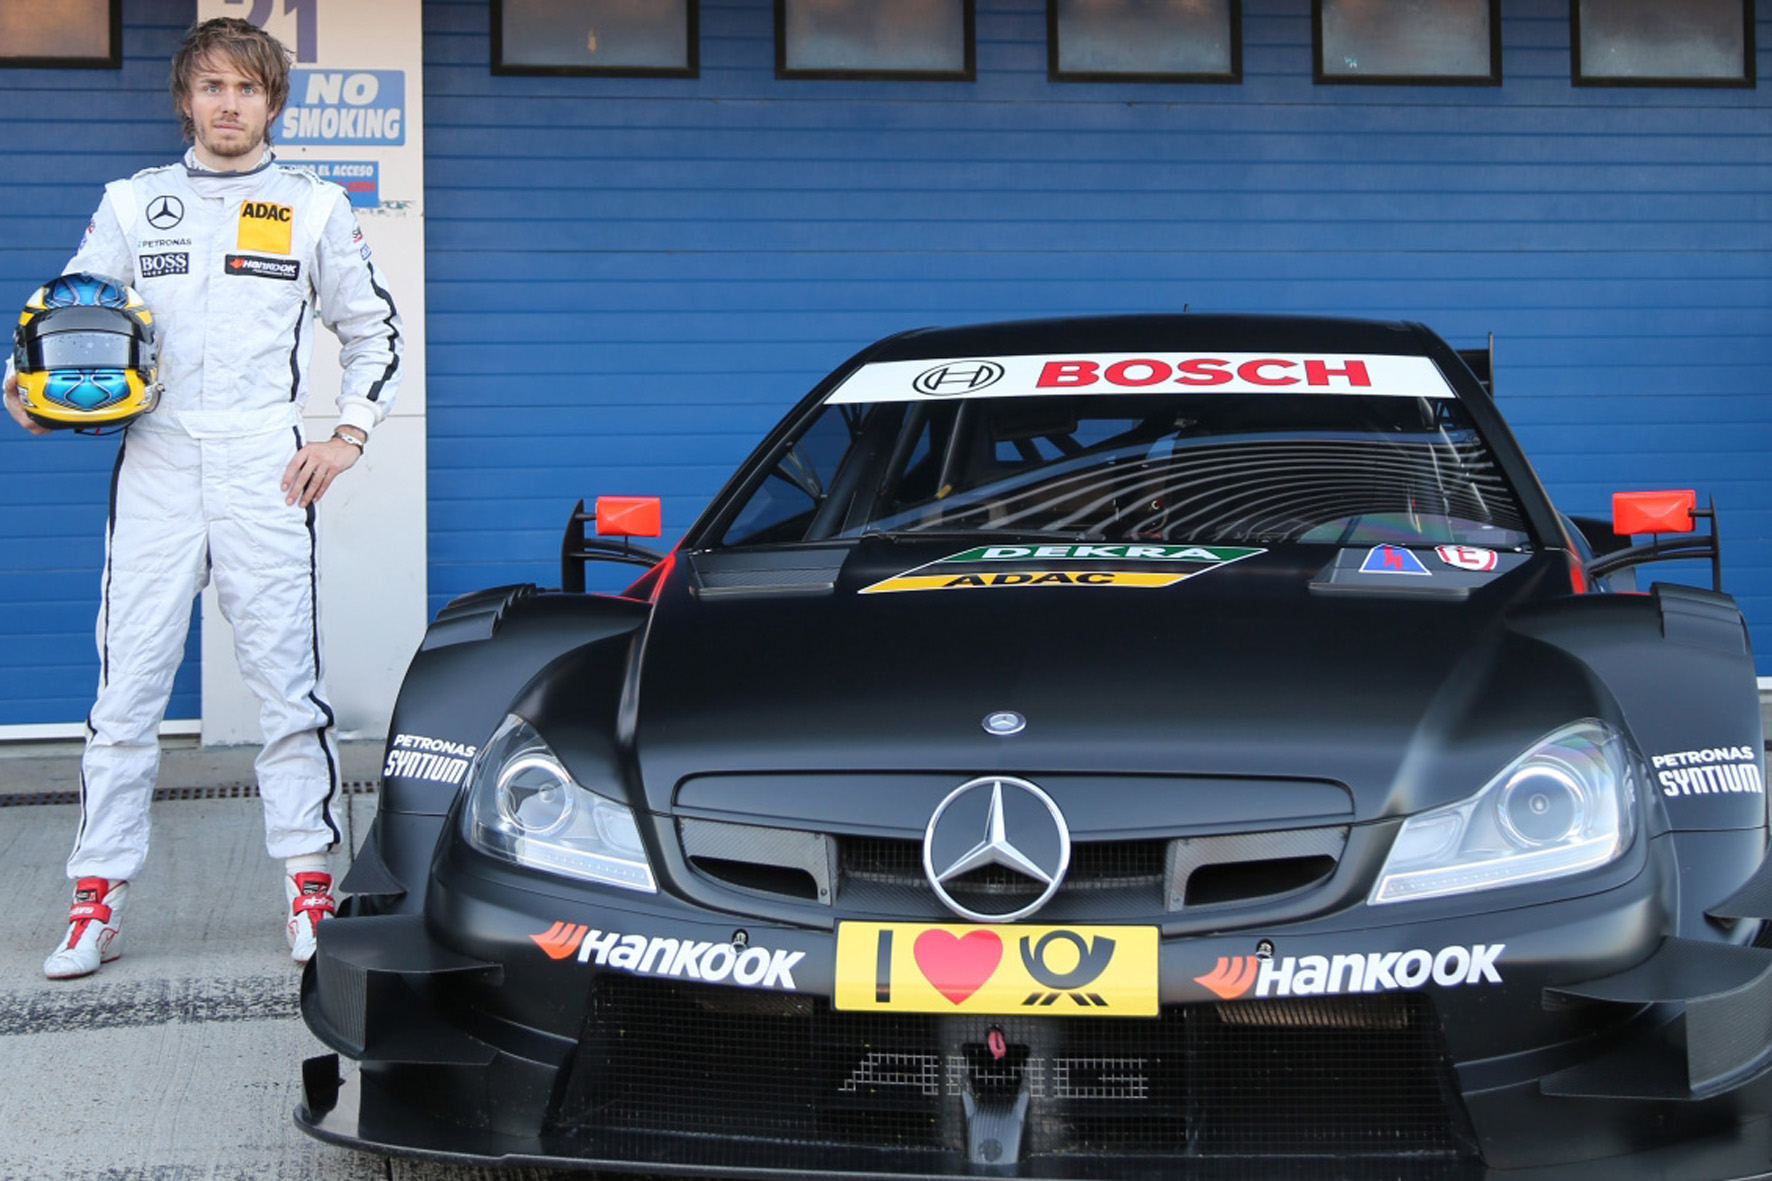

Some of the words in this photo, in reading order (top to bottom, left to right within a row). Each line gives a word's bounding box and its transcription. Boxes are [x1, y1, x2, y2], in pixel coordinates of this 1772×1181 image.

[305, 73, 379, 106] NO
[282, 106, 401, 140] SMOKING
[318, 164, 332, 177] EL
[332, 164, 374, 177] ACCESO
[242, 203, 290, 222] ADAC
[142, 238, 192, 248] PETRONAS
[142, 253, 188, 271] BOSS
[1034, 359, 1372, 389] BOSCH
[980, 546, 1222, 560] DEKRA
[941, 571, 1116, 588] ADAC
[393, 734, 477, 758] PETRONAS
[1651, 746, 1755, 769] PETRONAS
[384, 749, 469, 785] SYNTIUM
[1658, 763, 1764, 797] SYNTIUM
[875, 929, 894, 1004] I
